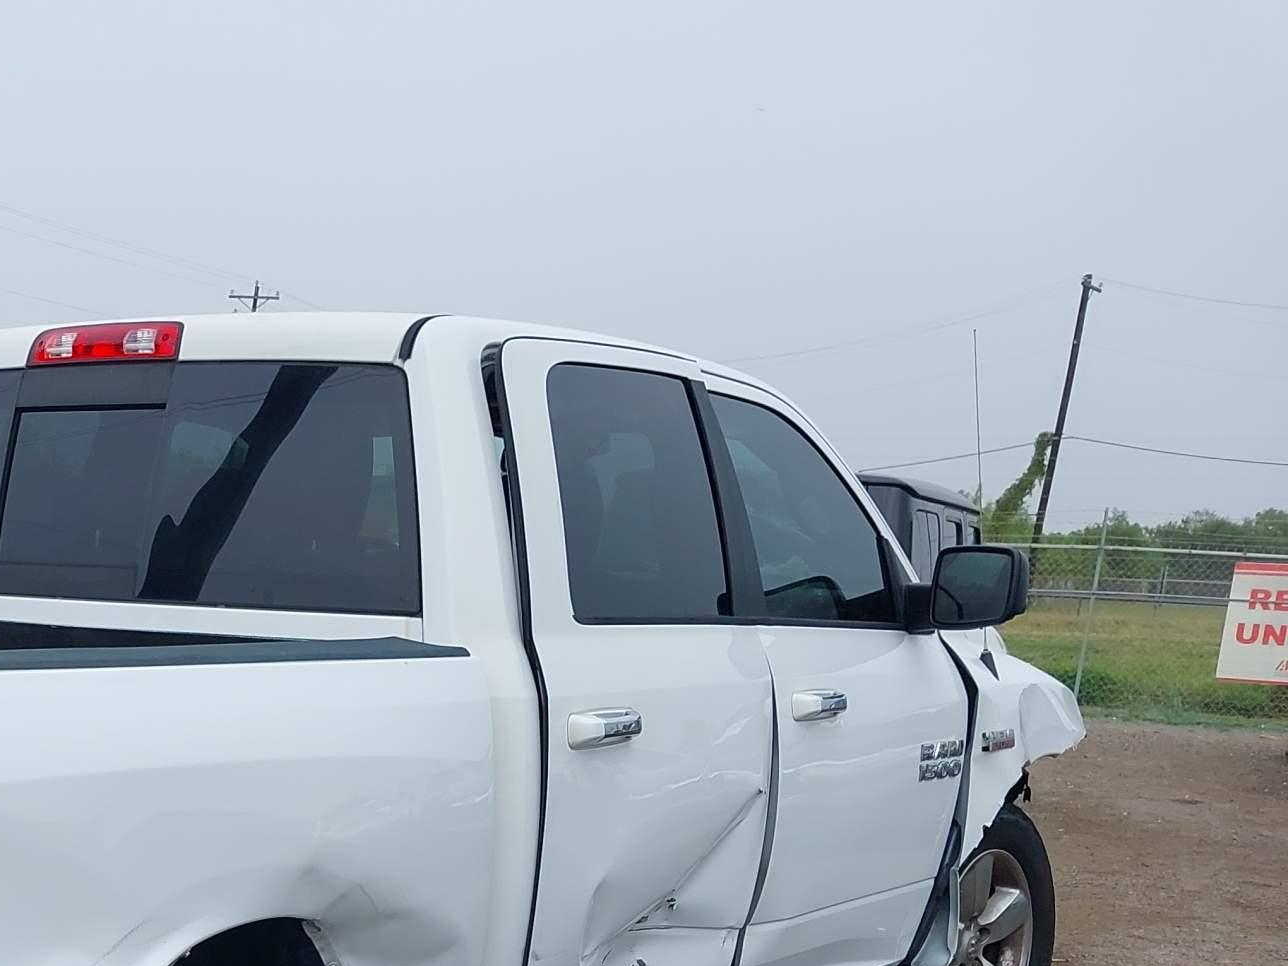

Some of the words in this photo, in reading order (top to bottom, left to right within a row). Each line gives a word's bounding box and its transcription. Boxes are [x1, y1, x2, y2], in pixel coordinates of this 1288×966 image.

[1236, 622, 1288, 646] UN
[920, 739, 964, 761] RAM
[918, 759, 962, 782] 1500
